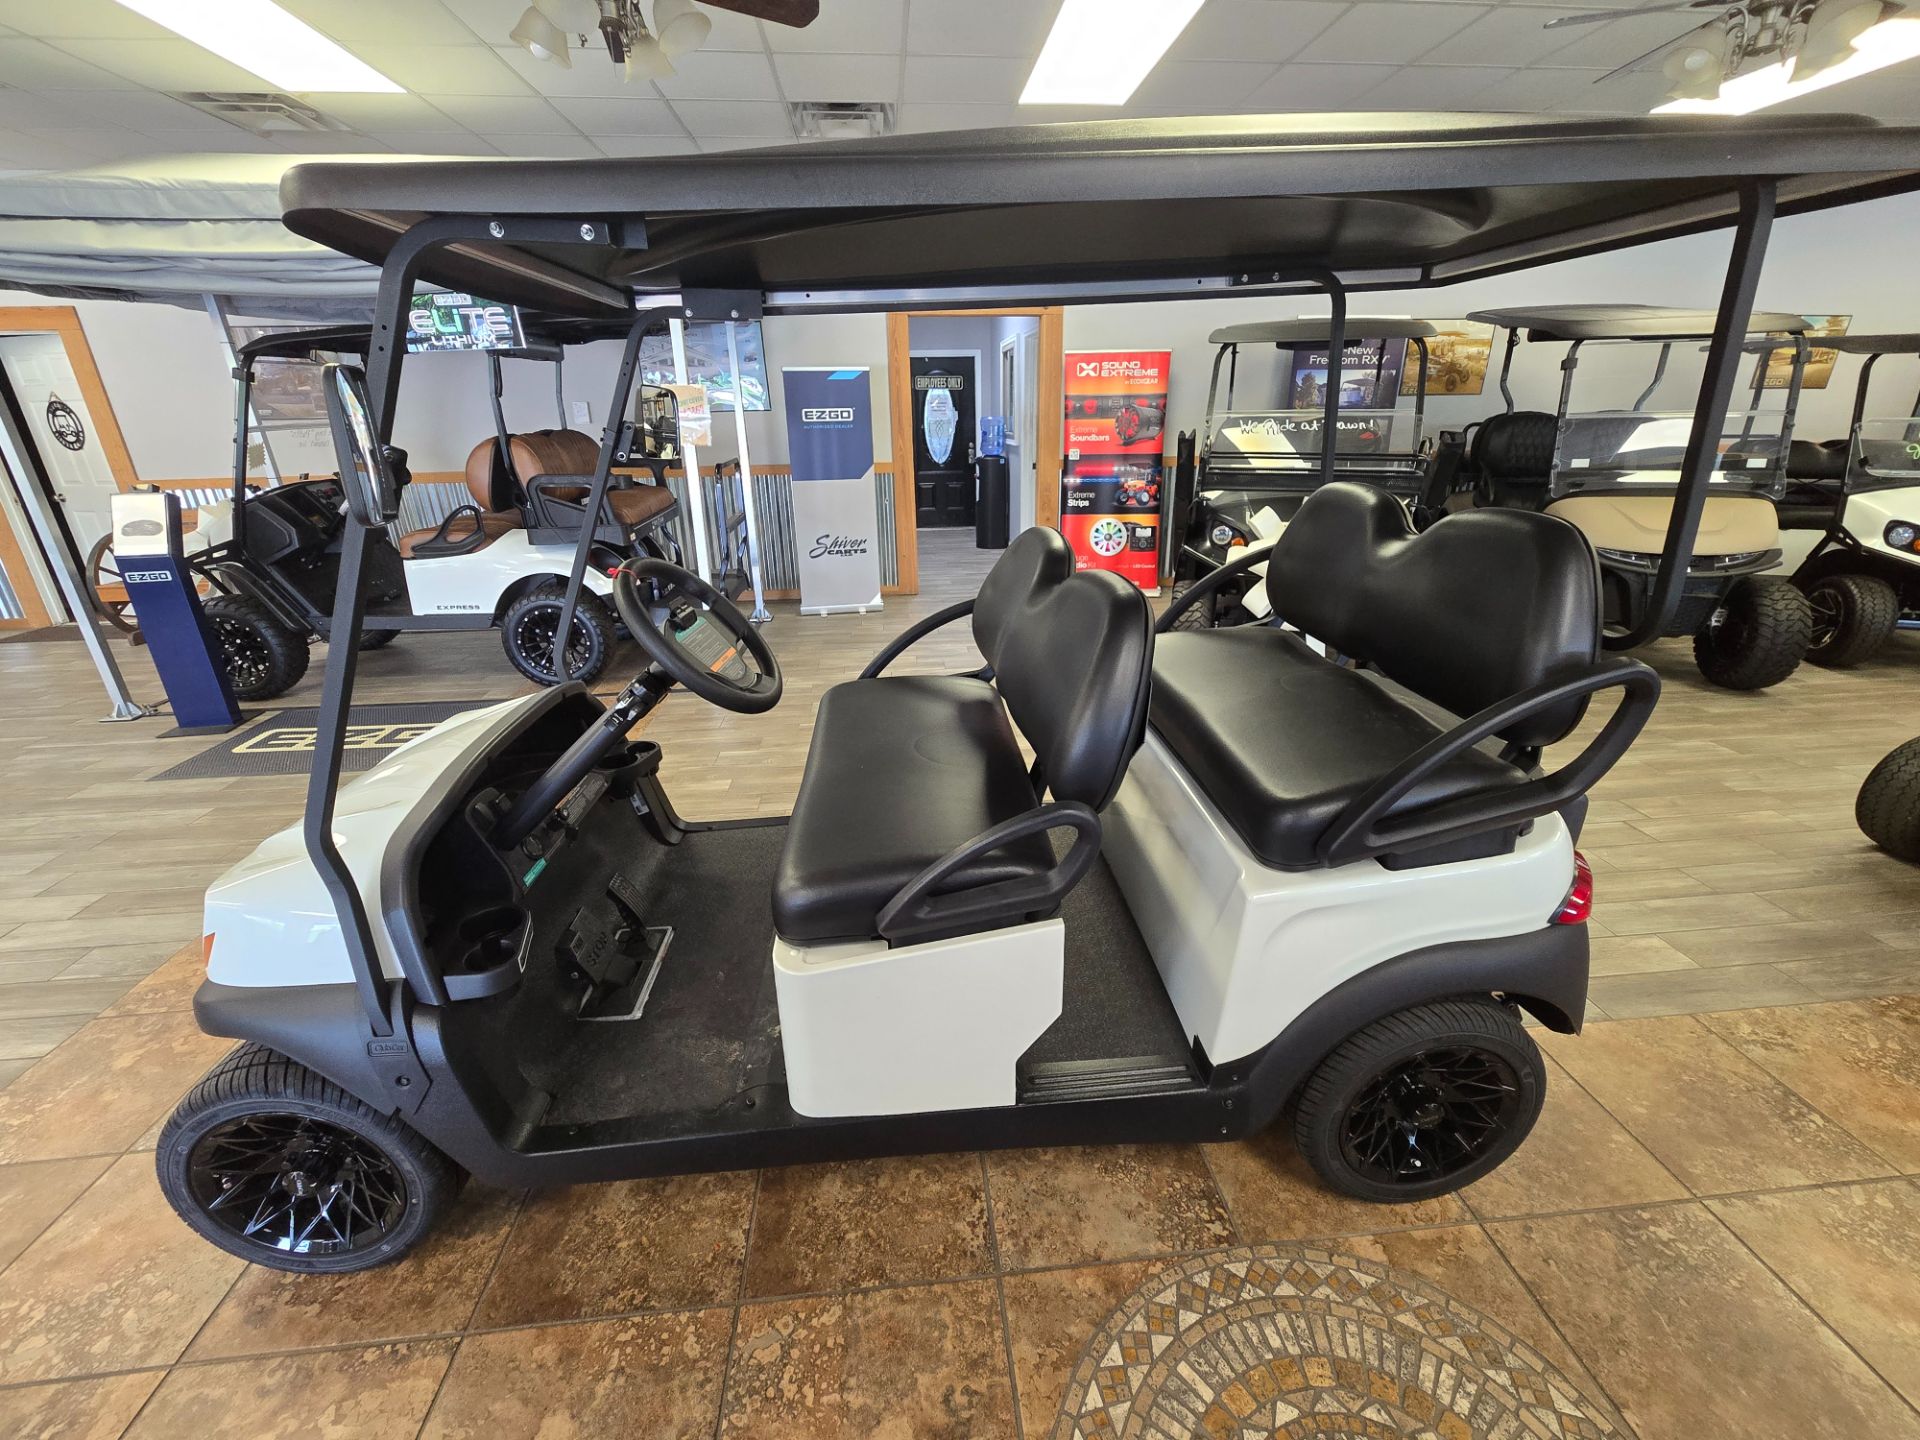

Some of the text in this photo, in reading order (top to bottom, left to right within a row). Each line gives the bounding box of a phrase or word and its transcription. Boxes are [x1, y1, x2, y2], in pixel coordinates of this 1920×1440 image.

[431, 335, 498, 346] LITHIUM
[1343, 346, 1374, 355] -New
[1309, 354, 1359, 365] Freom
[1101, 361, 1141, 369] SOUND
[1101, 369, 1159, 377] EXTREME
[917, 377, 961, 388] EMPLOYEES ONLY
[1300, 419, 1321, 431] at
[1322, 418, 1375, 431] awn!
[1067, 490, 1096, 499] Extreme
[1067, 499, 1090, 508] Strips
[809, 534, 868, 559] Shiver
